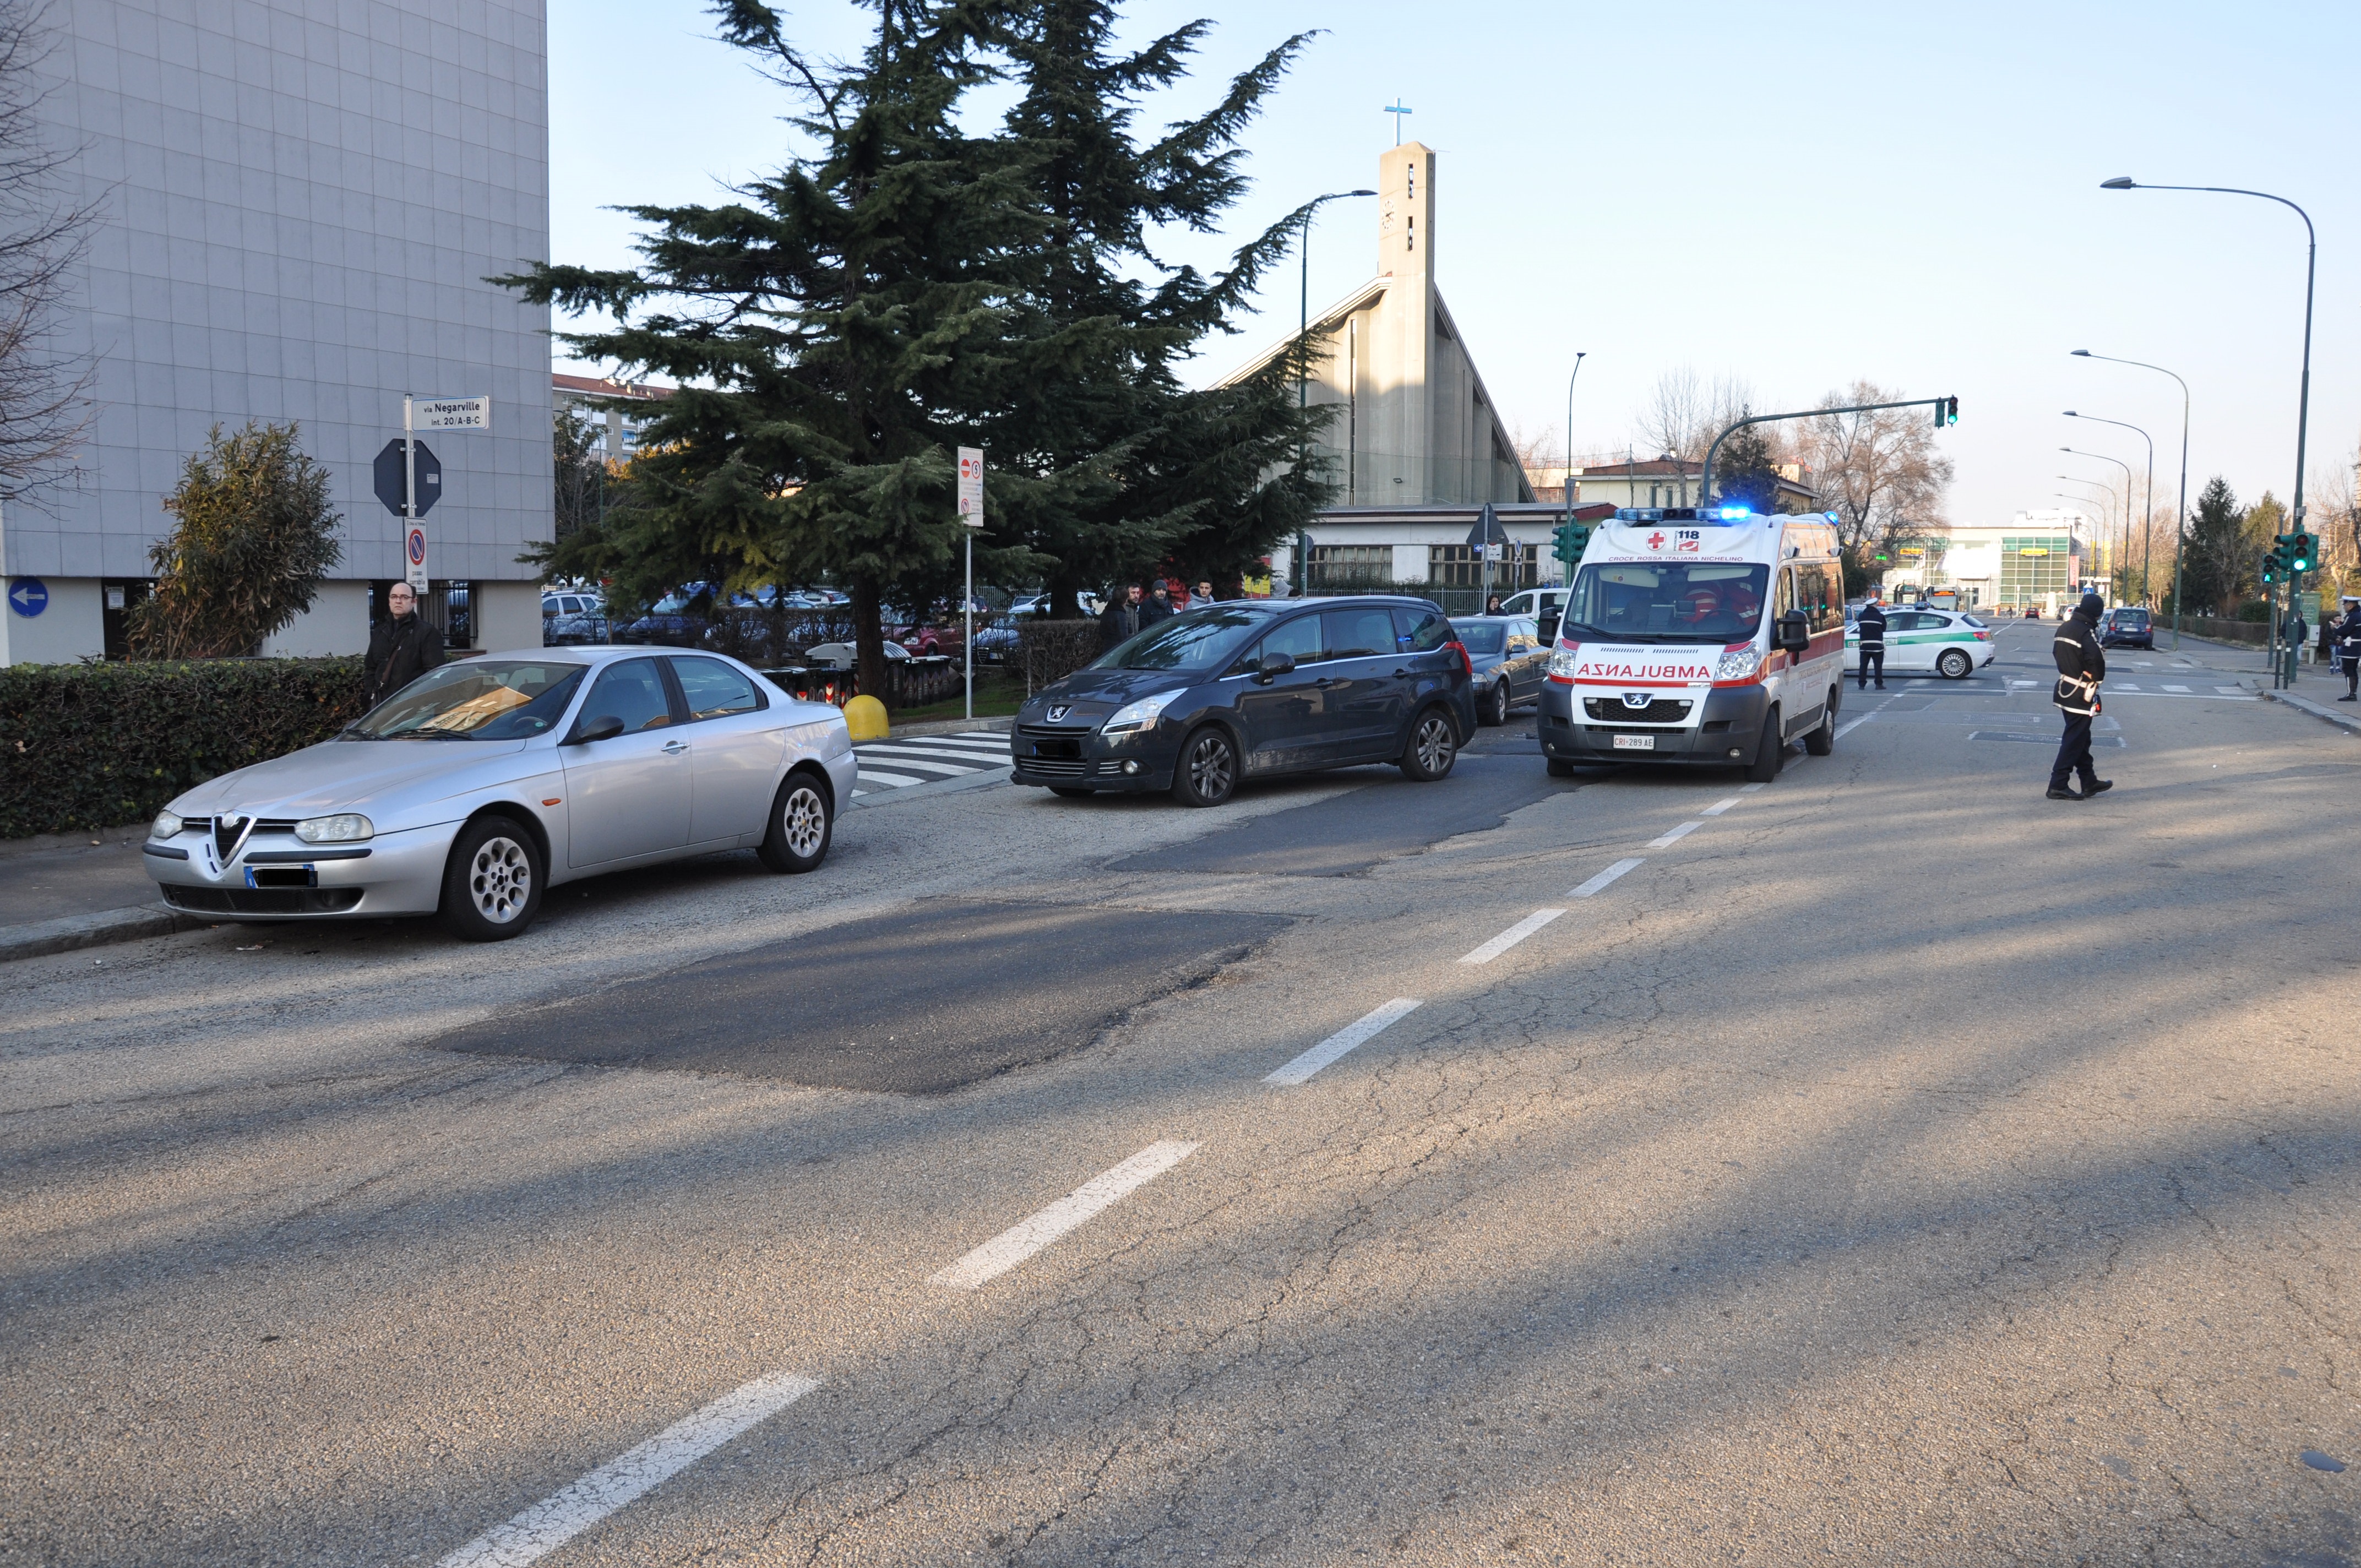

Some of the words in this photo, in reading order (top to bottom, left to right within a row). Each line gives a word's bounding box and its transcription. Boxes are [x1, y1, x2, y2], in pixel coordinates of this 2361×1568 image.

[435, 402, 480, 413] Negarville
[444, 416, 480, 426] 20/A-B-C
[1678, 530, 1700, 540] 118
[1614, 738, 1625, 746] CRI
[1629, 738, 1642, 747] 289
[1644, 738, 1653, 747] AE
